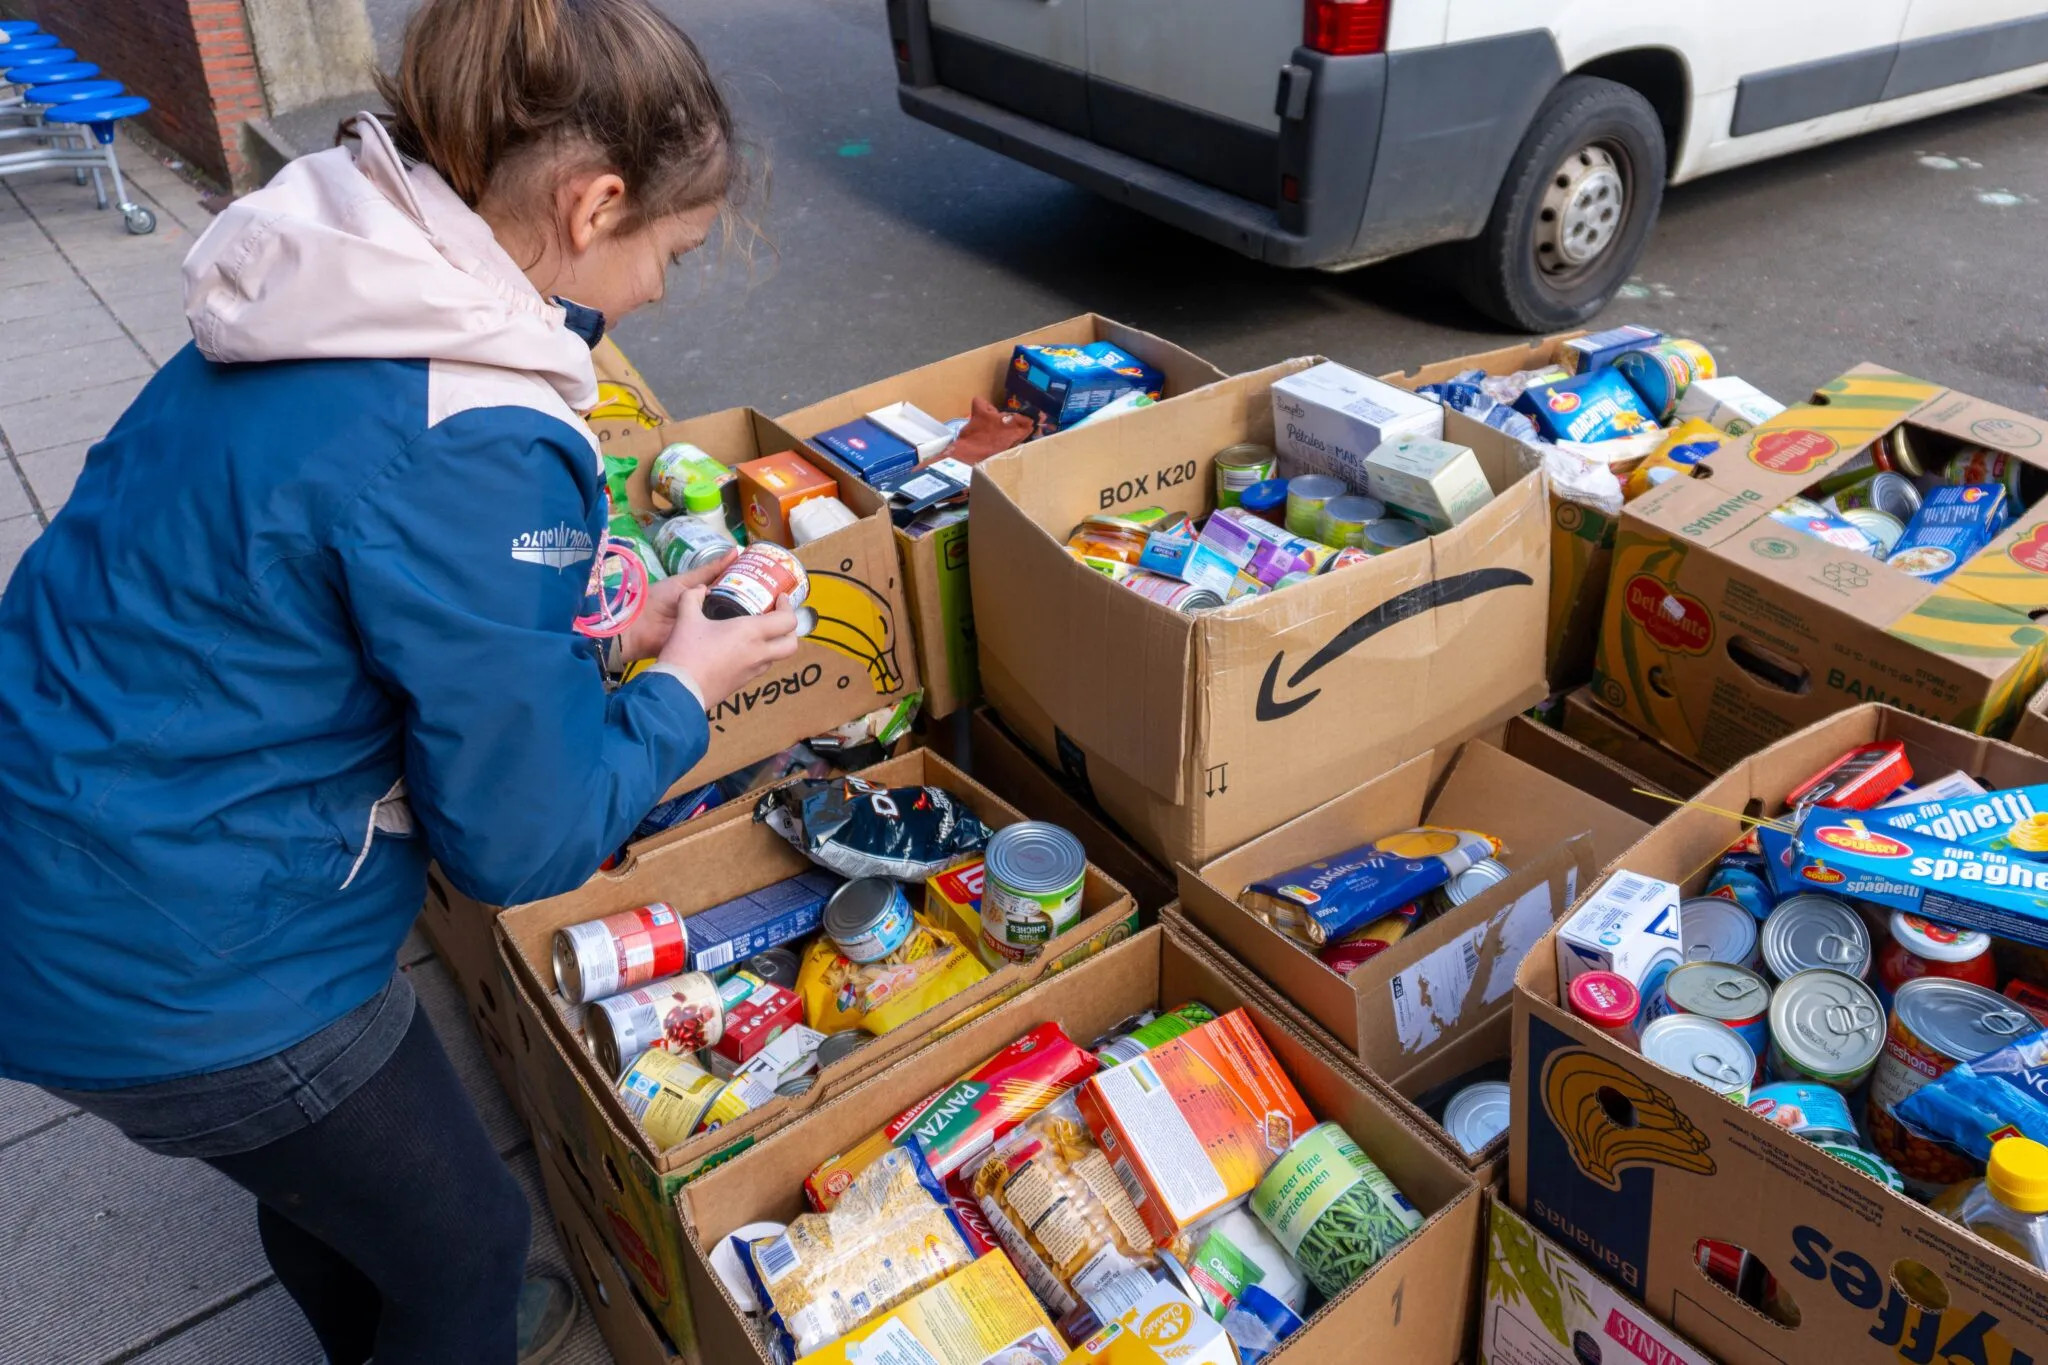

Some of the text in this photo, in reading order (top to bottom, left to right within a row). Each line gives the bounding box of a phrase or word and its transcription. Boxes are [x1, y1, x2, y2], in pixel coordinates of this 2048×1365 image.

[1286, 423, 1326, 452] Pétales
[1100, 459, 1197, 510] BOX K20
[1683, 490, 1763, 537] BANANAS
[706, 663, 822, 724] ORGAN
[1914, 789, 2036, 842] aghetti
[1825, 832, 1899, 855] SOUBRY
[1309, 856, 1385, 891] SPAGHETTI
[1804, 869, 1841, 883] SOUBRY
[1846, 879, 1920, 899] spaghetti
[1910, 855, 2048, 891] spaghe
[1009, 923, 1046, 934] CHICHES
[916, 1084, 981, 1143] PANZA
[1727, 1136, 1766, 1161] Company
[1278, 1176, 1299, 1201] zeer
[1296, 1151, 1323, 1179] fijne
[1277, 1168, 1331, 1234] sperziebonen
[1801, 1179, 1855, 1212] International
[1532, 1200, 1638, 1288] Bananas
[1209, 1257, 1242, 1290] Classic
[1962, 1270, 2024, 1307] International
[1143, 1303, 1183, 1340] Classic
